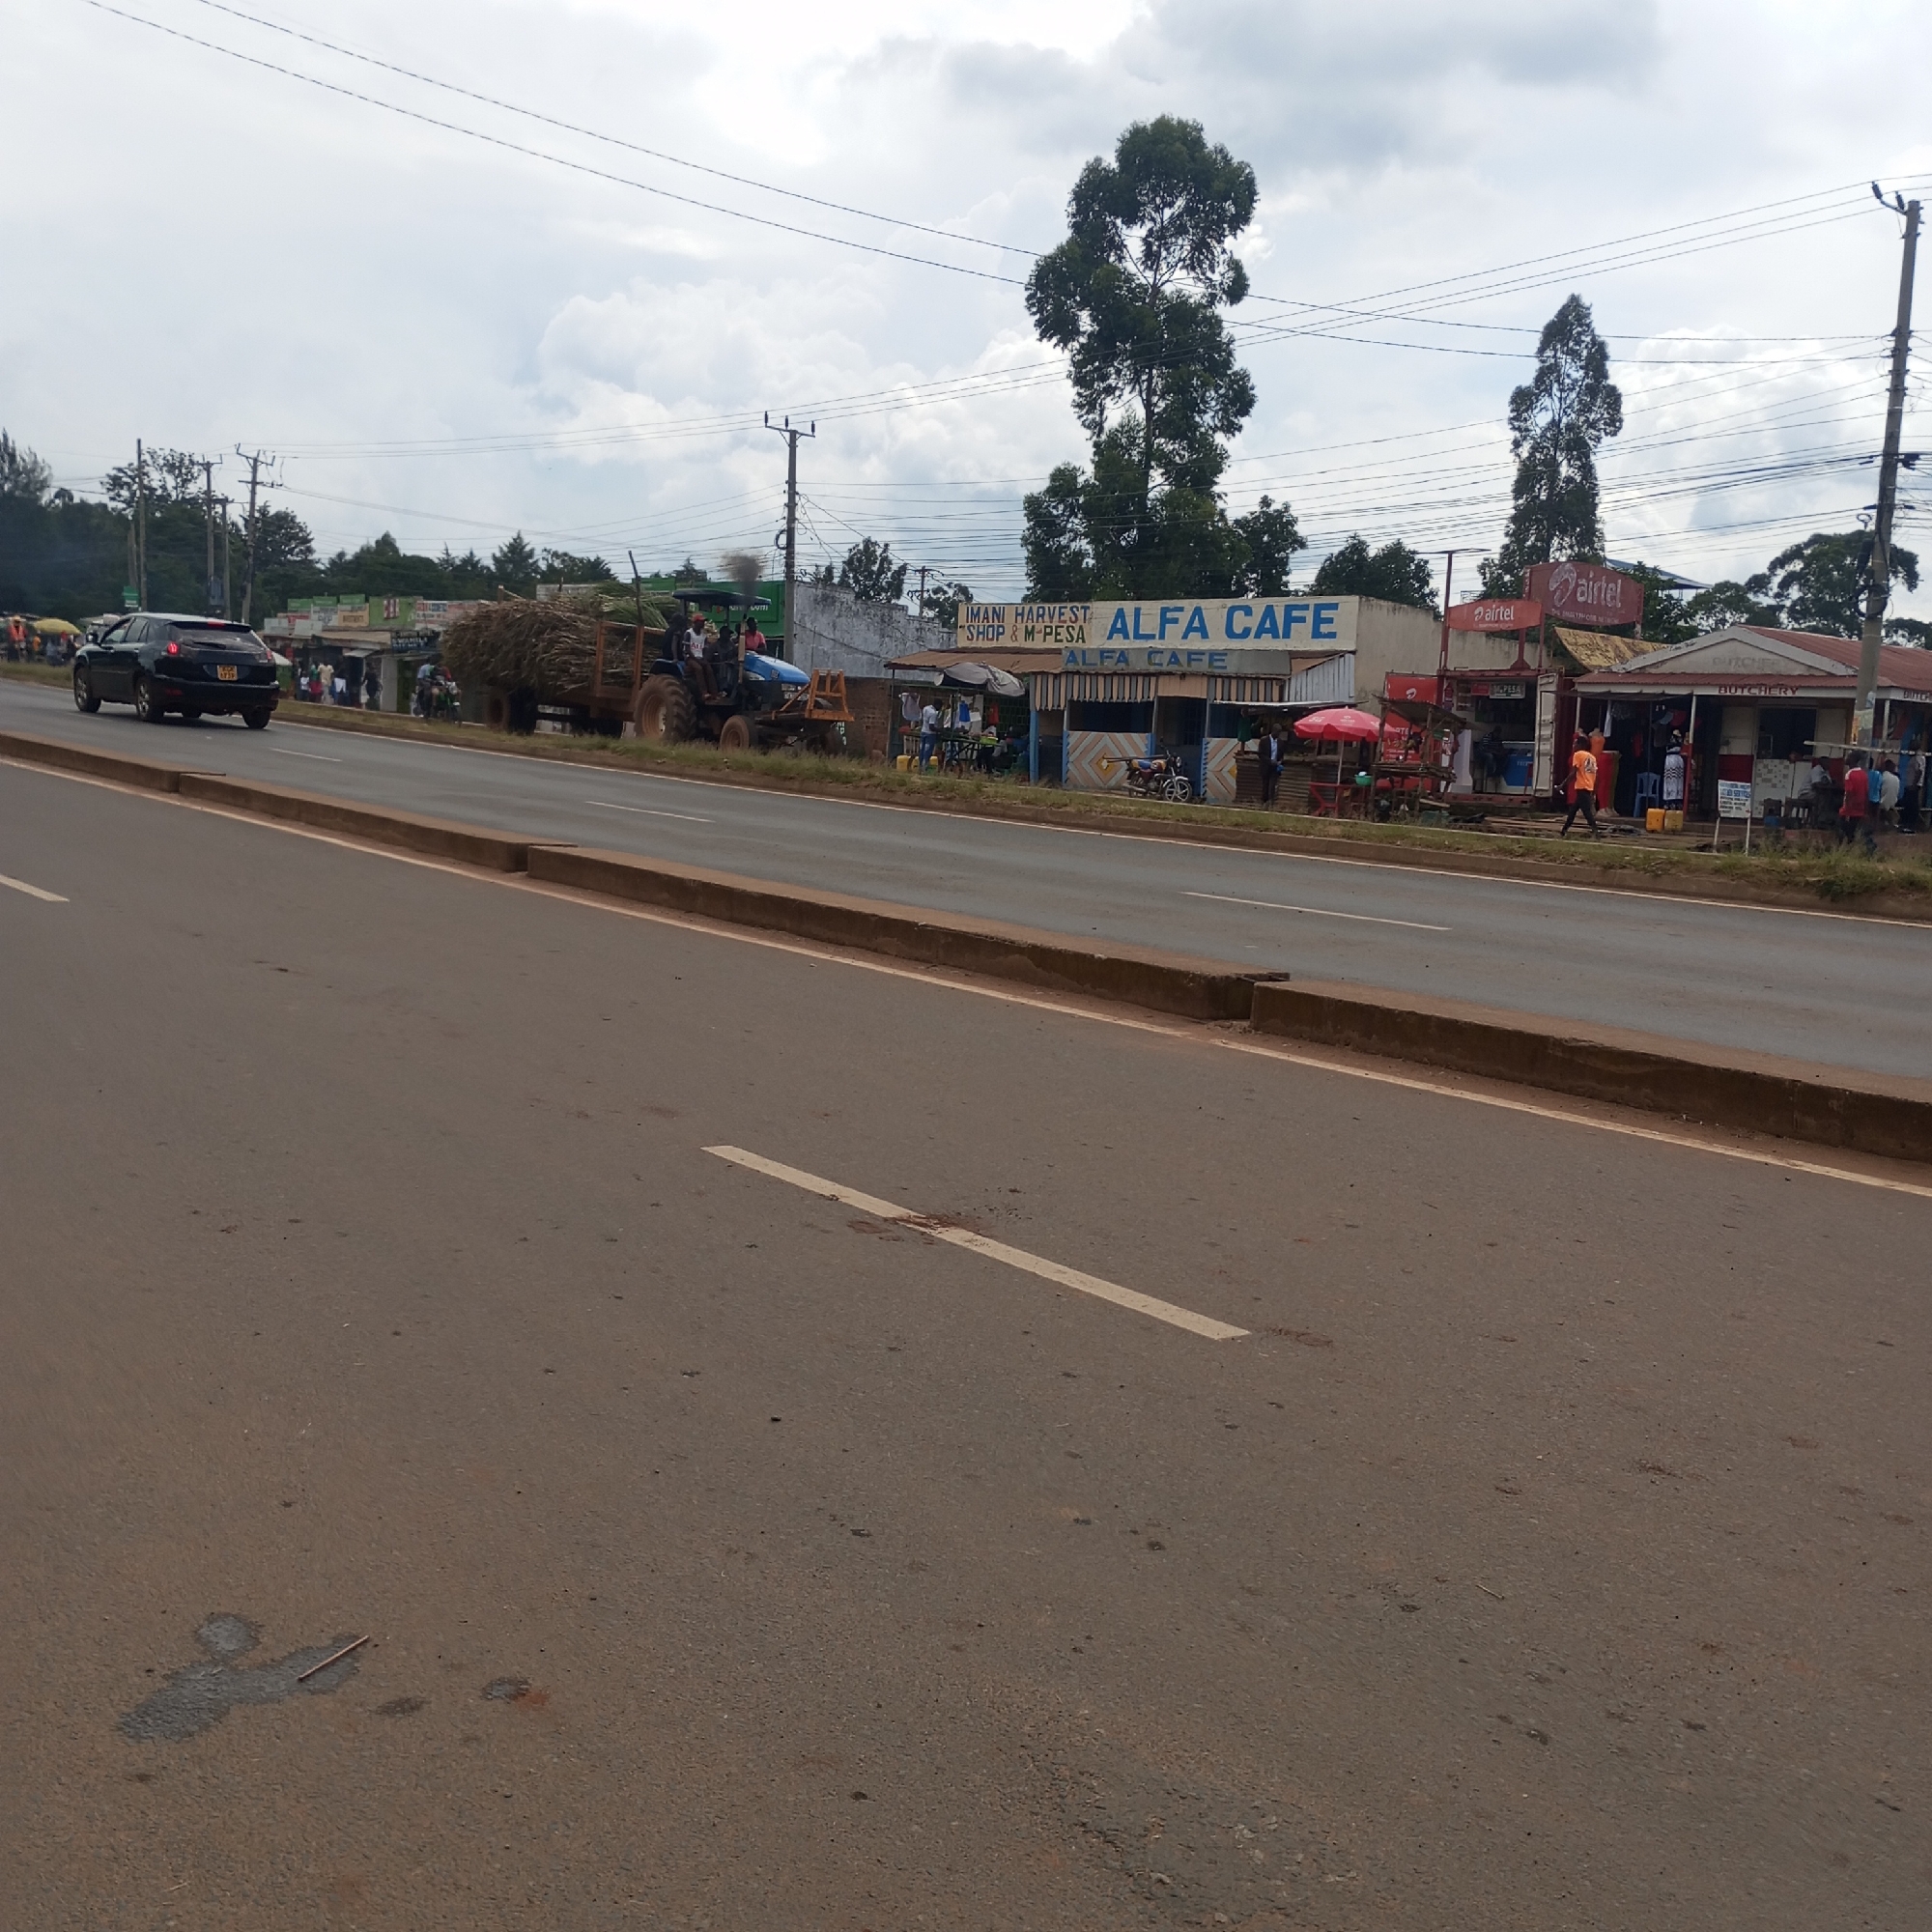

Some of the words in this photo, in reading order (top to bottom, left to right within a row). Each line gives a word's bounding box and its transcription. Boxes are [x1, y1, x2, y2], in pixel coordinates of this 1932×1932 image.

[1577, 571, 1622, 608] airtel
[966, 606, 1006, 624] IMANI
[1015, 605, 1091, 625] HARVEST
[1106, 606, 1209, 641] ALFA
[1224, 602, 1340, 640] CAFE
[1485, 606, 1515, 621] airtel
[966, 624, 1006, 641] SHOP
[1010, 624, 1018, 643] &
[1024, 625, 1087, 644] M-PESA
[1065, 649, 1130, 667] ALFA
[1147, 650, 1228, 669] CAFE
[1719, 686, 1799, 696] BUTCHERY
